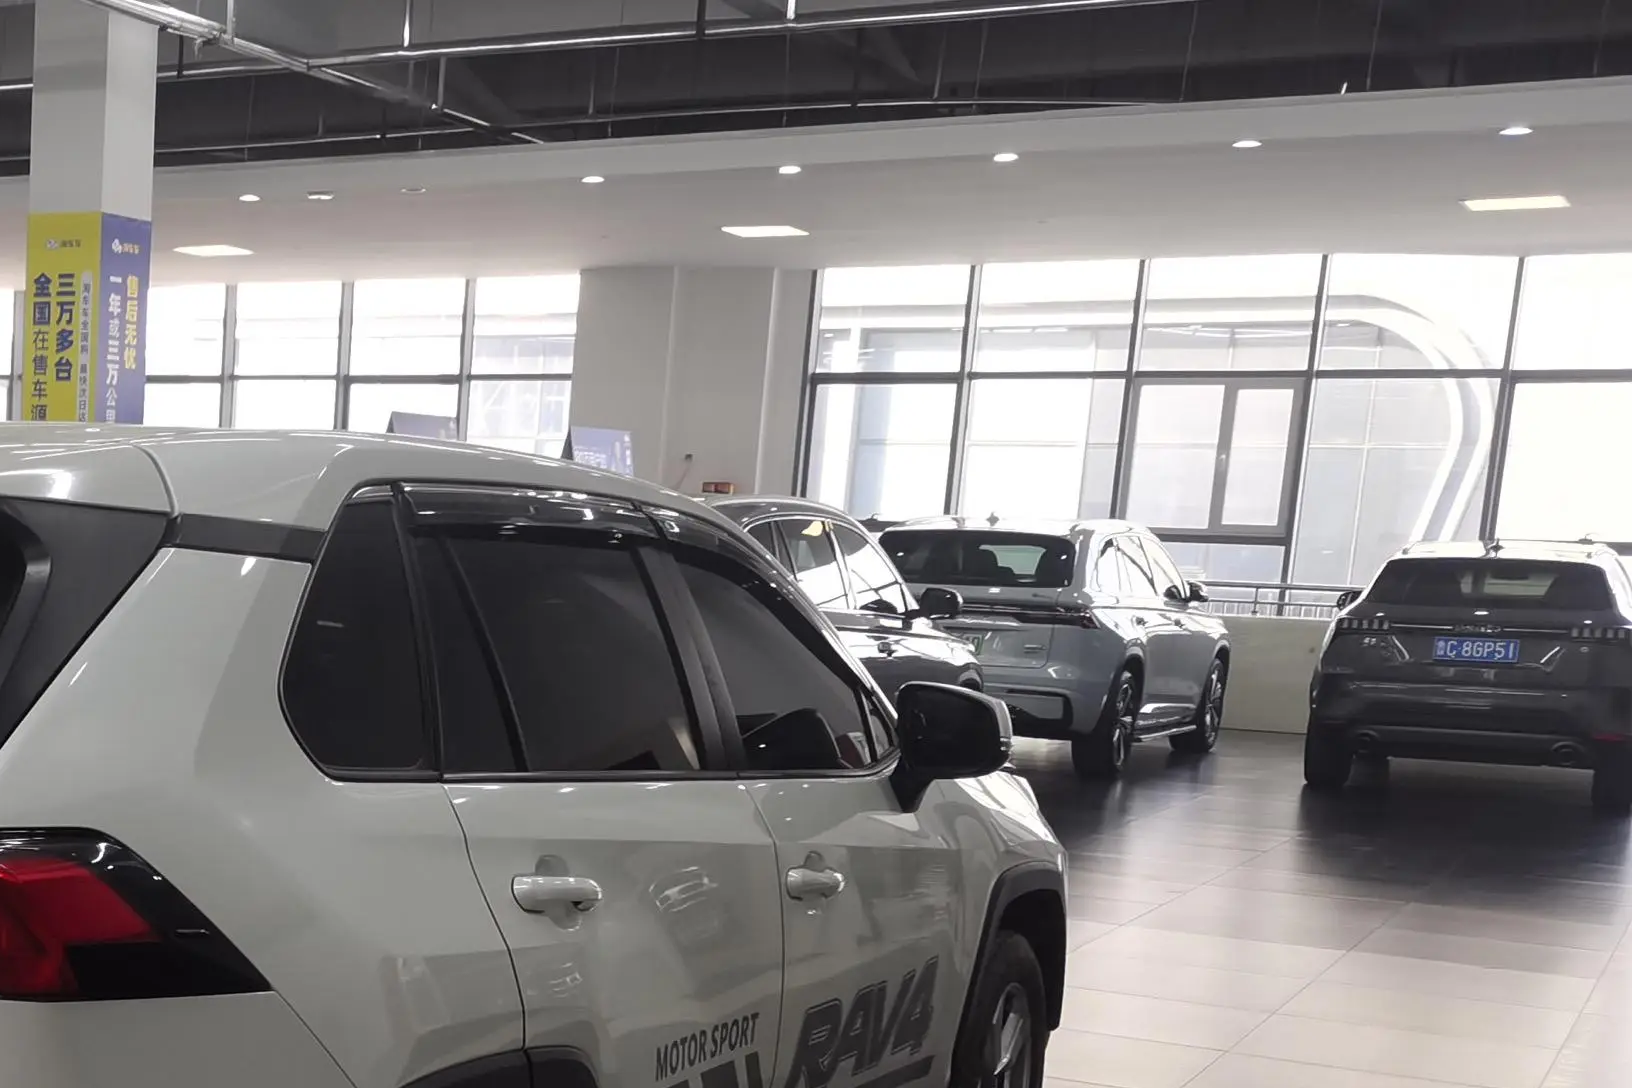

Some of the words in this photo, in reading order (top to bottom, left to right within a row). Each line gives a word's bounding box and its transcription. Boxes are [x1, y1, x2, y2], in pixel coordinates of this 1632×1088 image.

[31, 272, 53, 421] 全国在售车源
[54, 273, 76, 381] 三万多台
[124, 275, 139, 369] 售后无忧
[655, 1029, 707, 1082] MOTOR
[710, 1012, 760, 1059] SPORT
